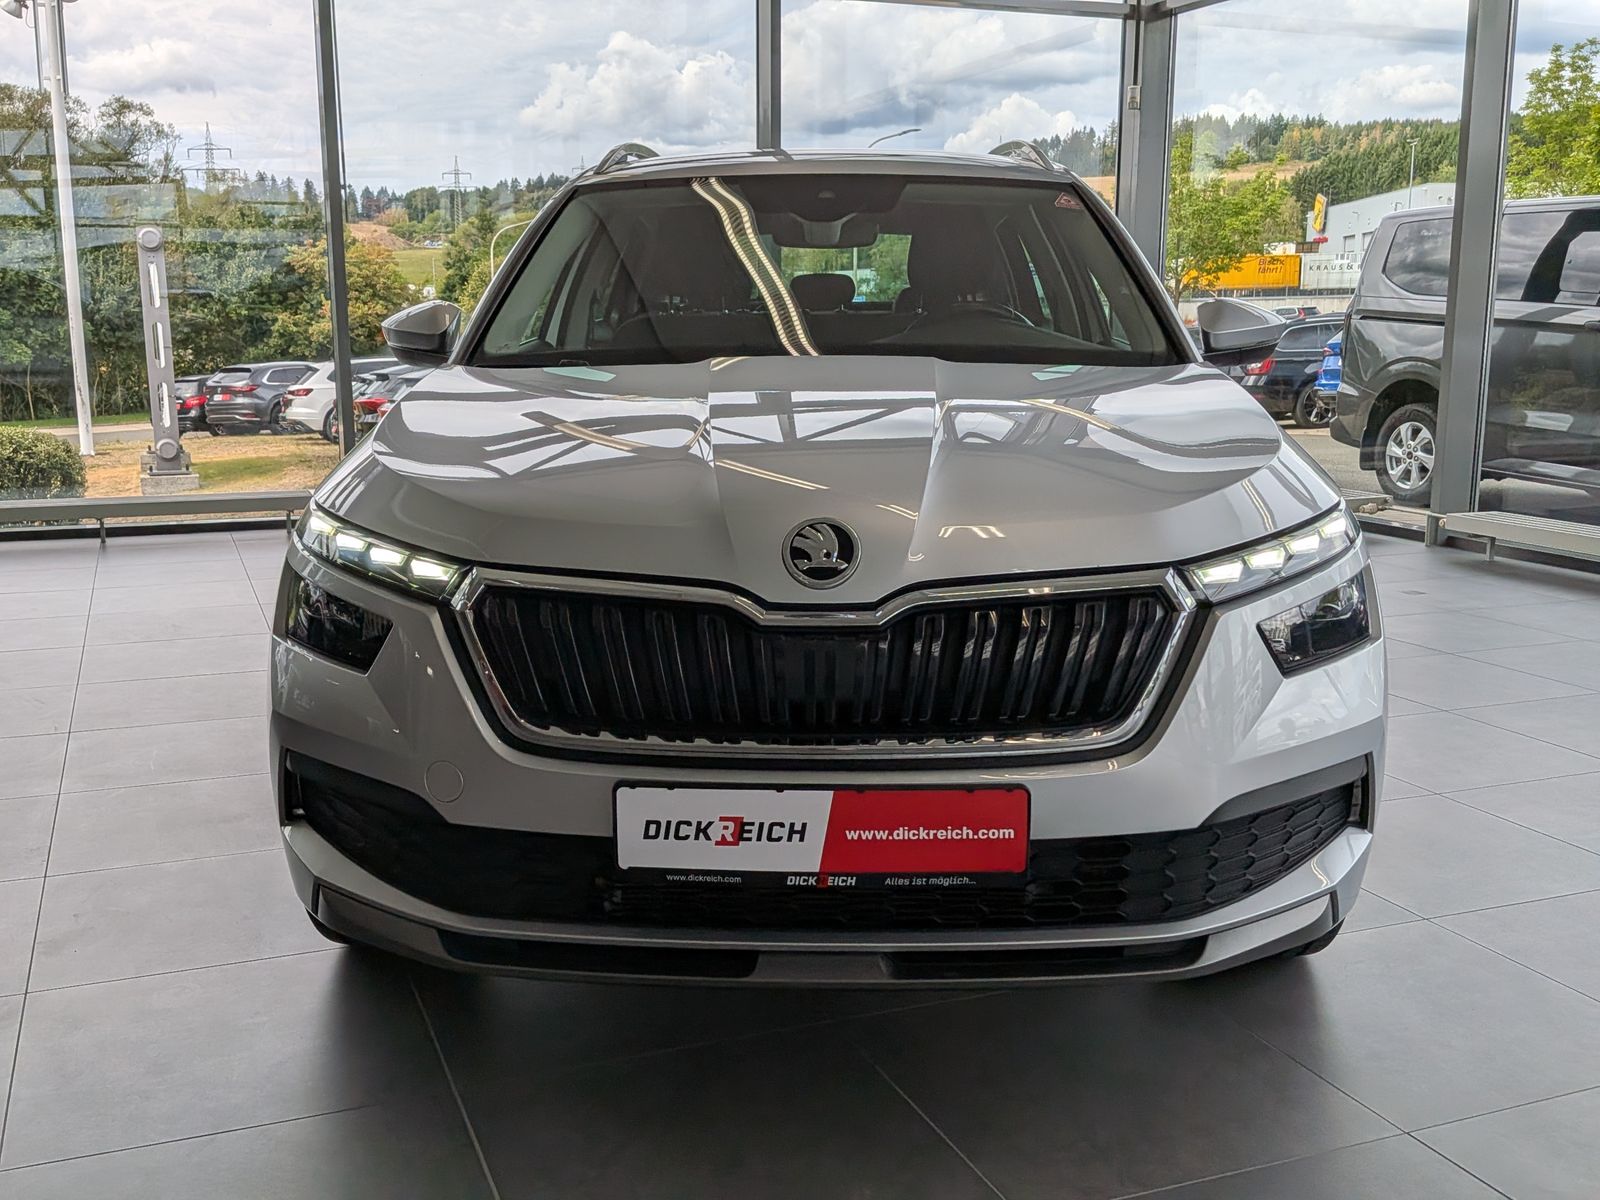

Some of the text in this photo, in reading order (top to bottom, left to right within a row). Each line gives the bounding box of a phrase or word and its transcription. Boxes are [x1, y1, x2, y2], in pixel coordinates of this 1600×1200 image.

[643, 817, 807, 845] DICKREICH
[845, 826, 1015, 840] www.dickreich.com
[666, 874, 742, 883] www.dickreich.com
[884, 877, 910, 886] Alles
[912, 877, 927, 885] ist
